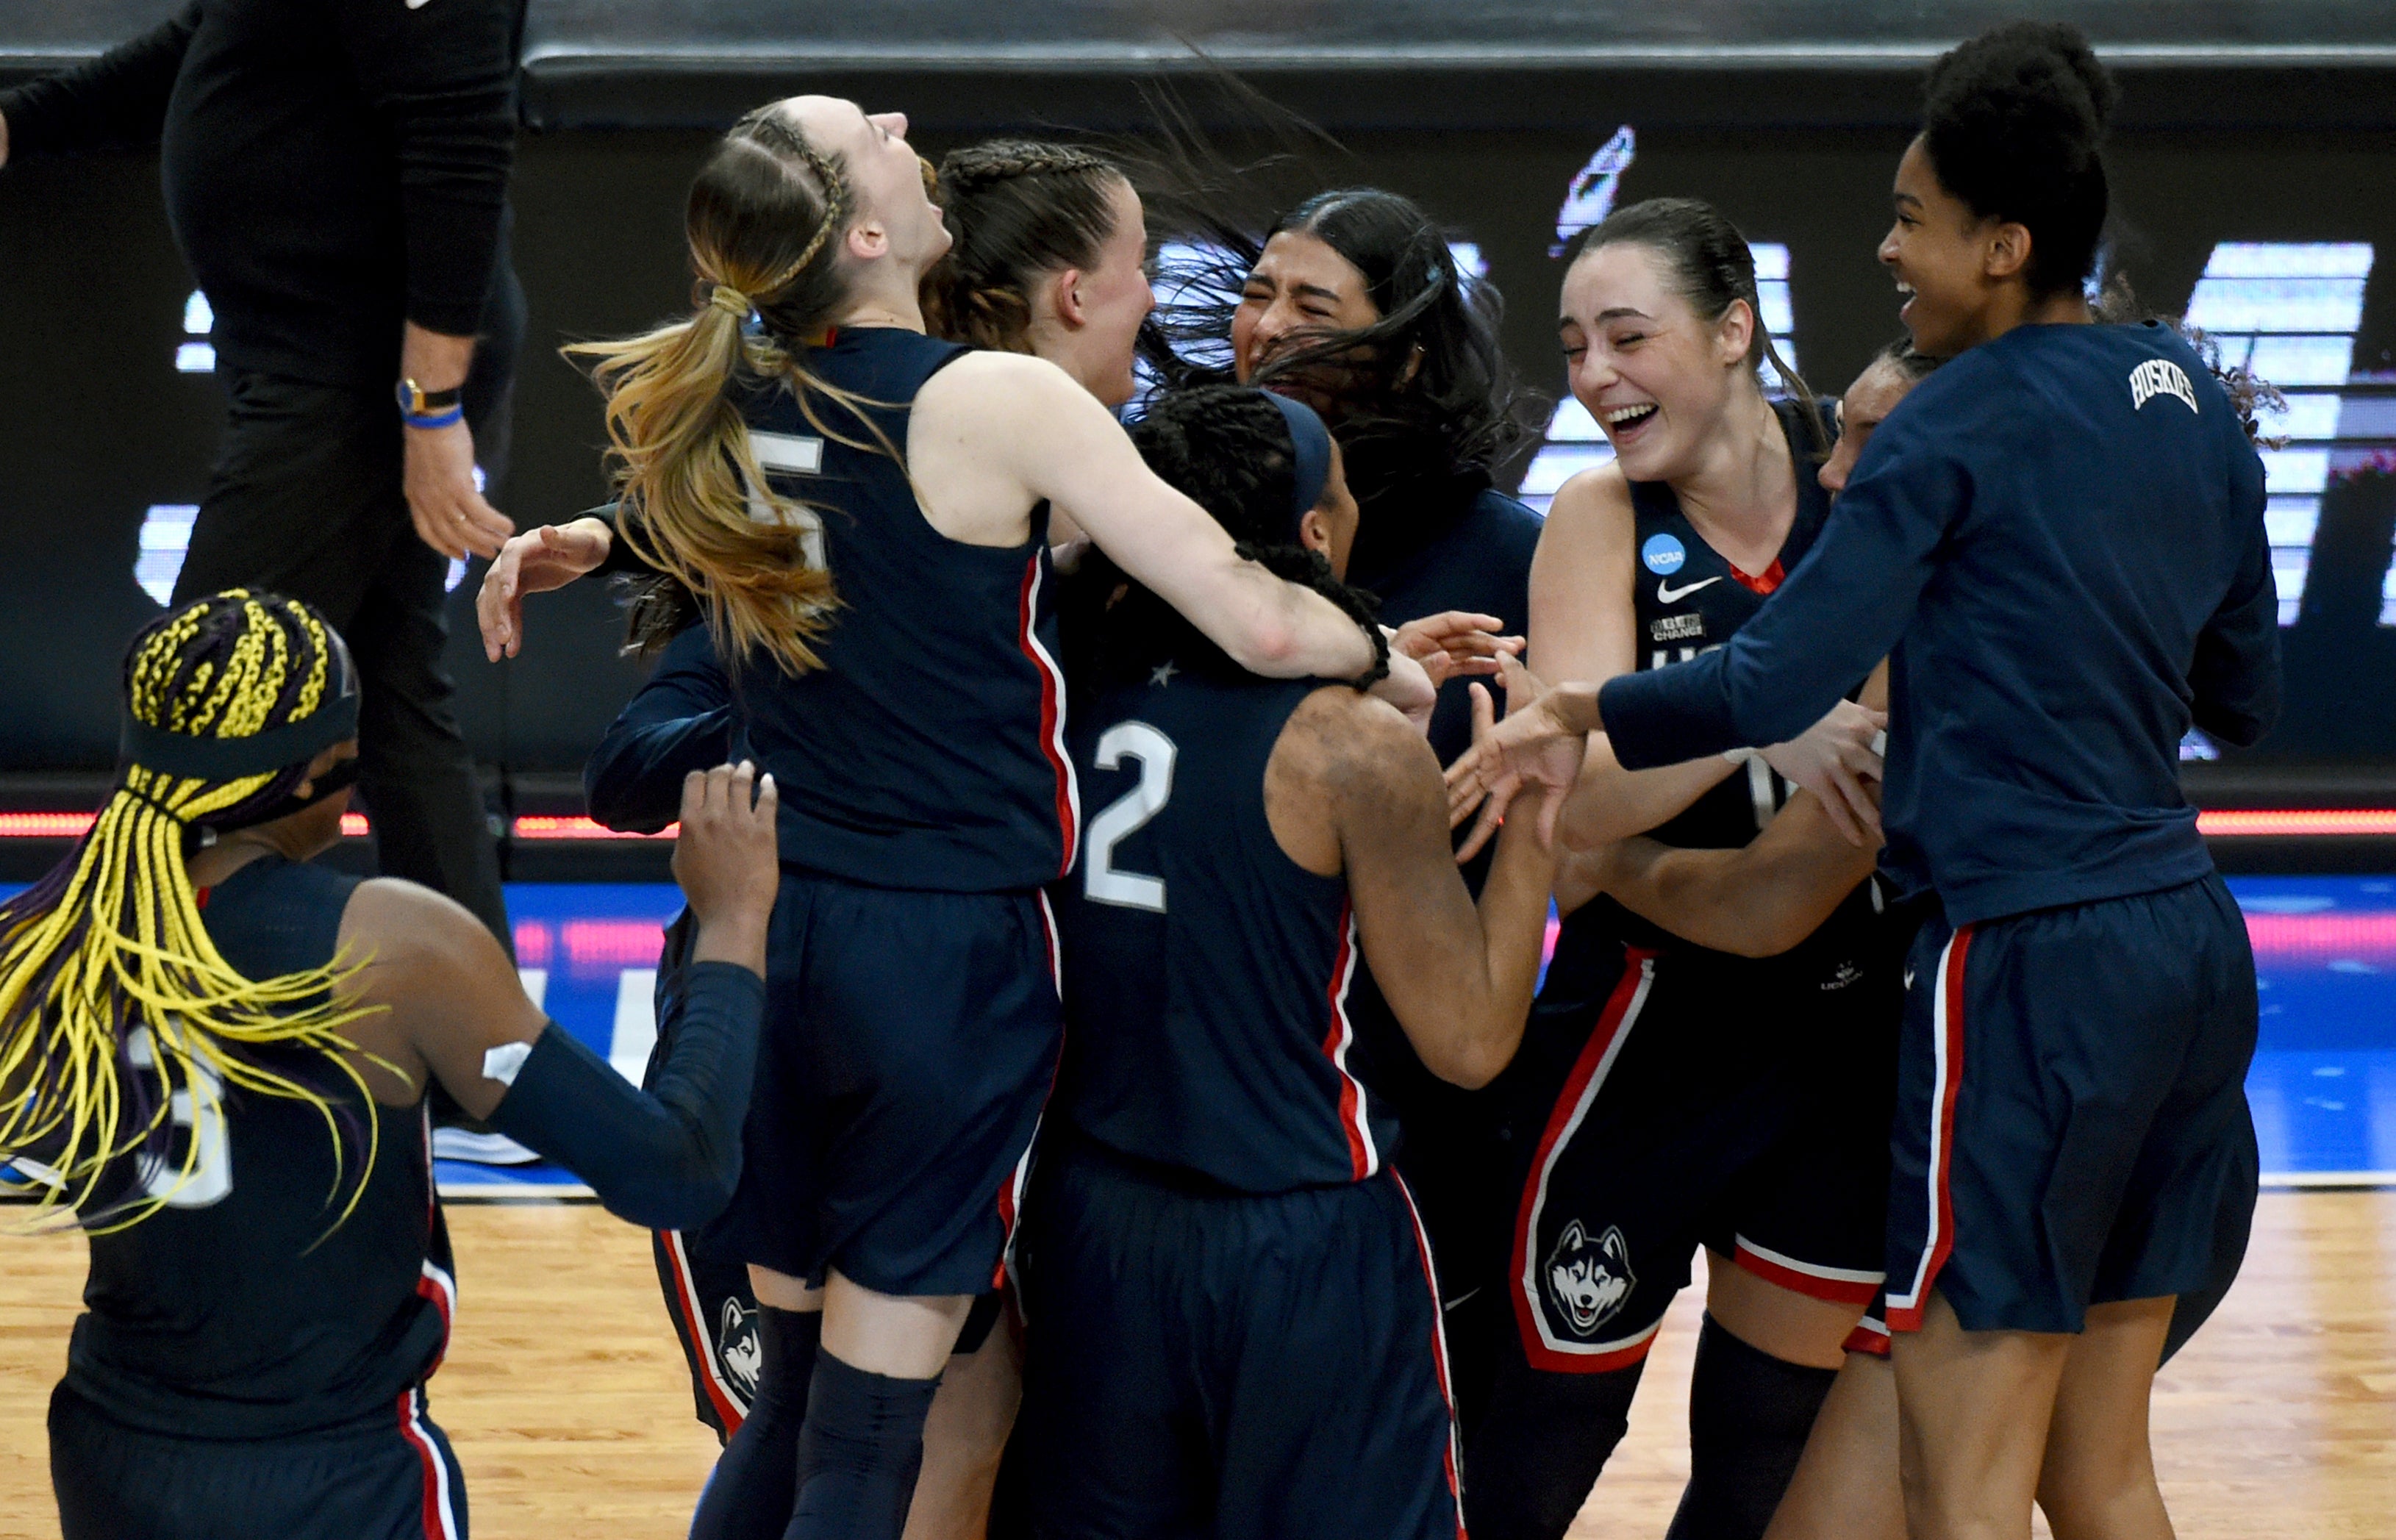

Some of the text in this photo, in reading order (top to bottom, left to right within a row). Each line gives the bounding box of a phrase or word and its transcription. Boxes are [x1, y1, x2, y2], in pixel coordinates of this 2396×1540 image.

[2129, 359, 2198, 415] HUSKIES
[1648, 551, 1684, 566] NCAA
[1084, 720, 1179, 914] 2
